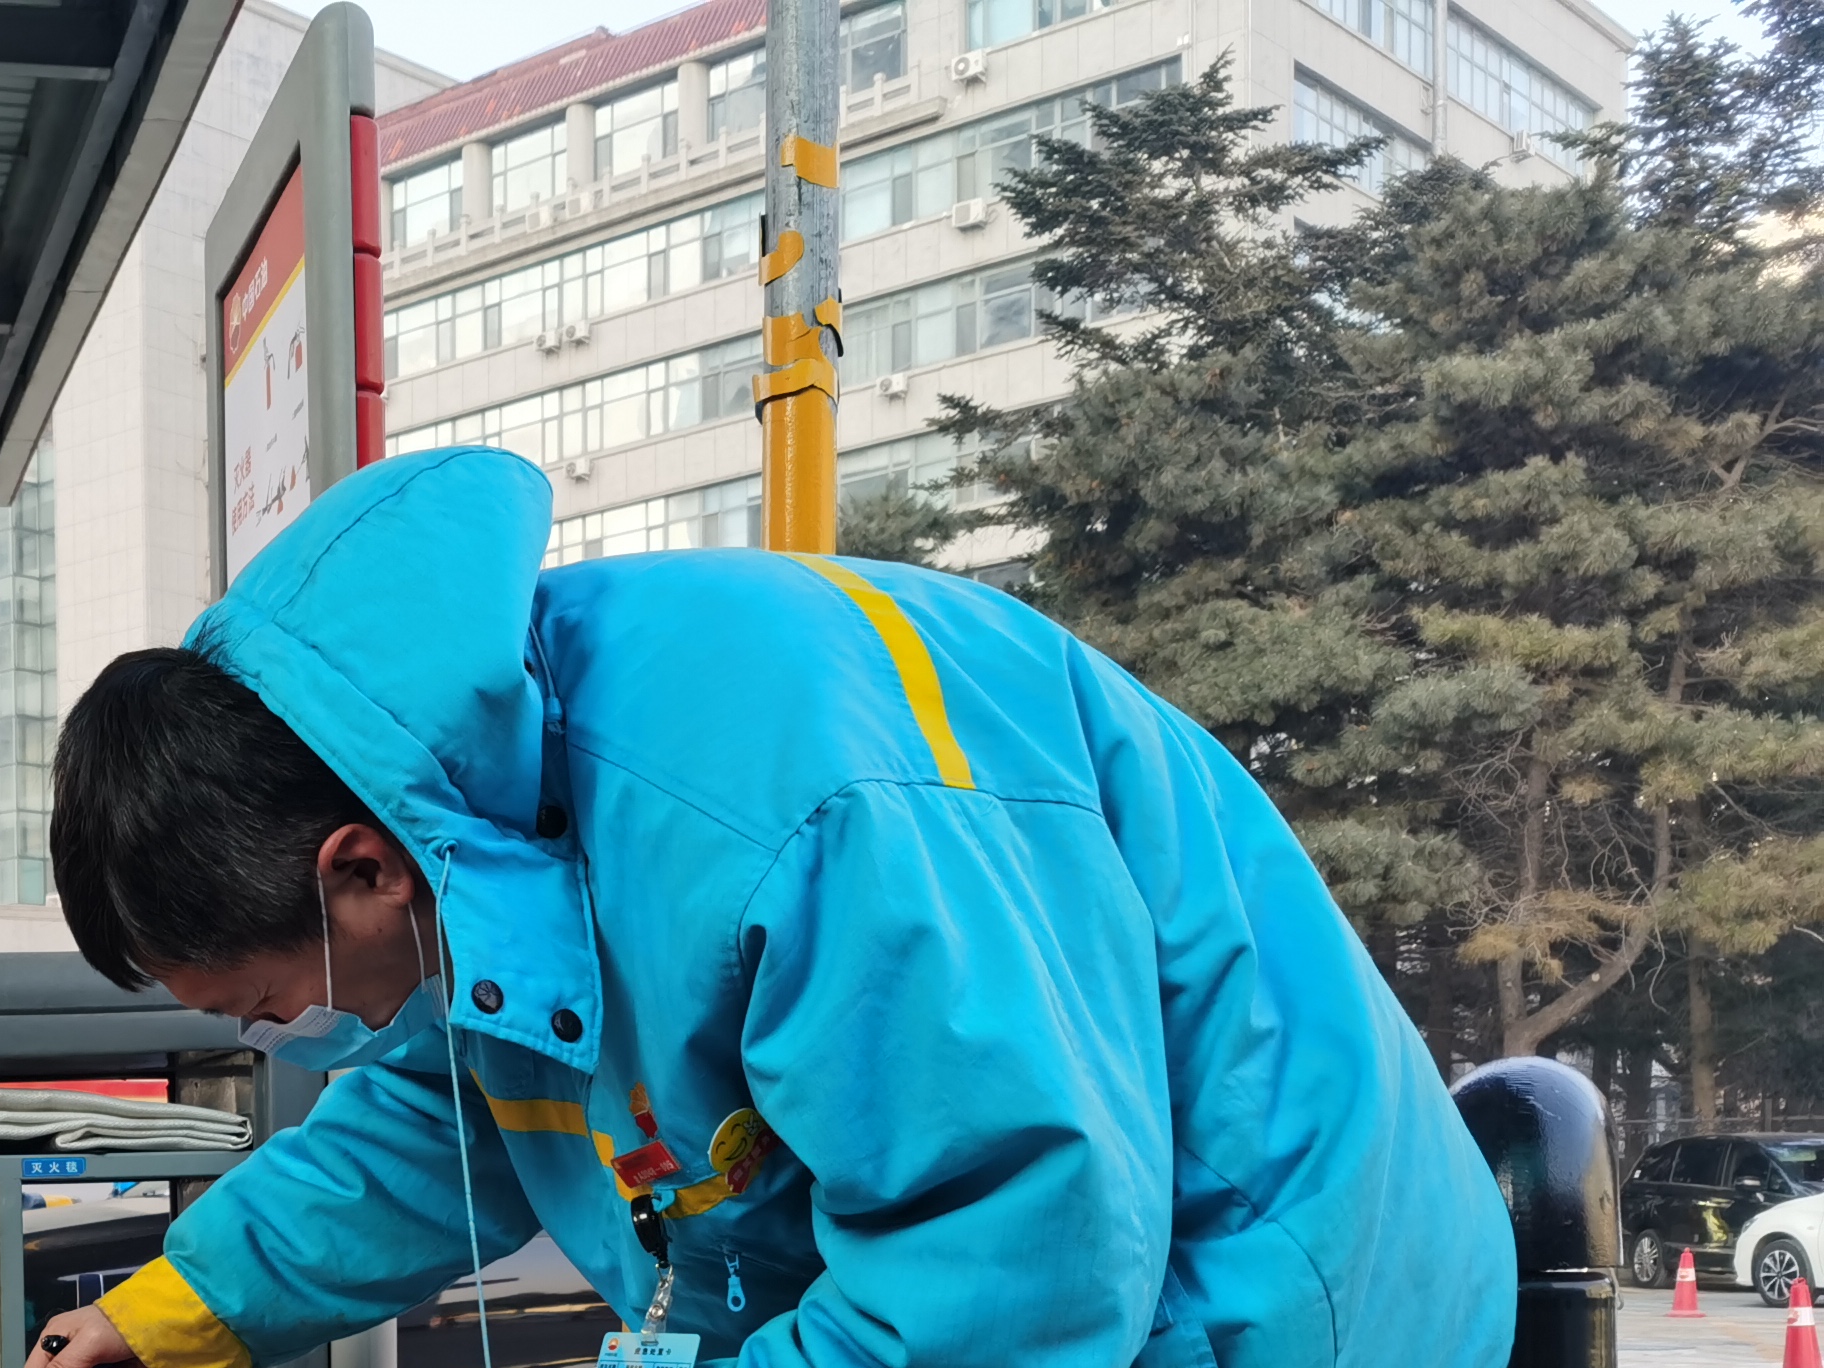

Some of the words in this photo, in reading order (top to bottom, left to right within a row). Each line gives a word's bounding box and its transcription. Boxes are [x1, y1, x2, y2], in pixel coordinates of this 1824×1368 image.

[242, 256, 268, 321] 中国石油
[234, 445, 252, 495] 灭火器
[31, 1161, 78, 1174] 灭火毯
